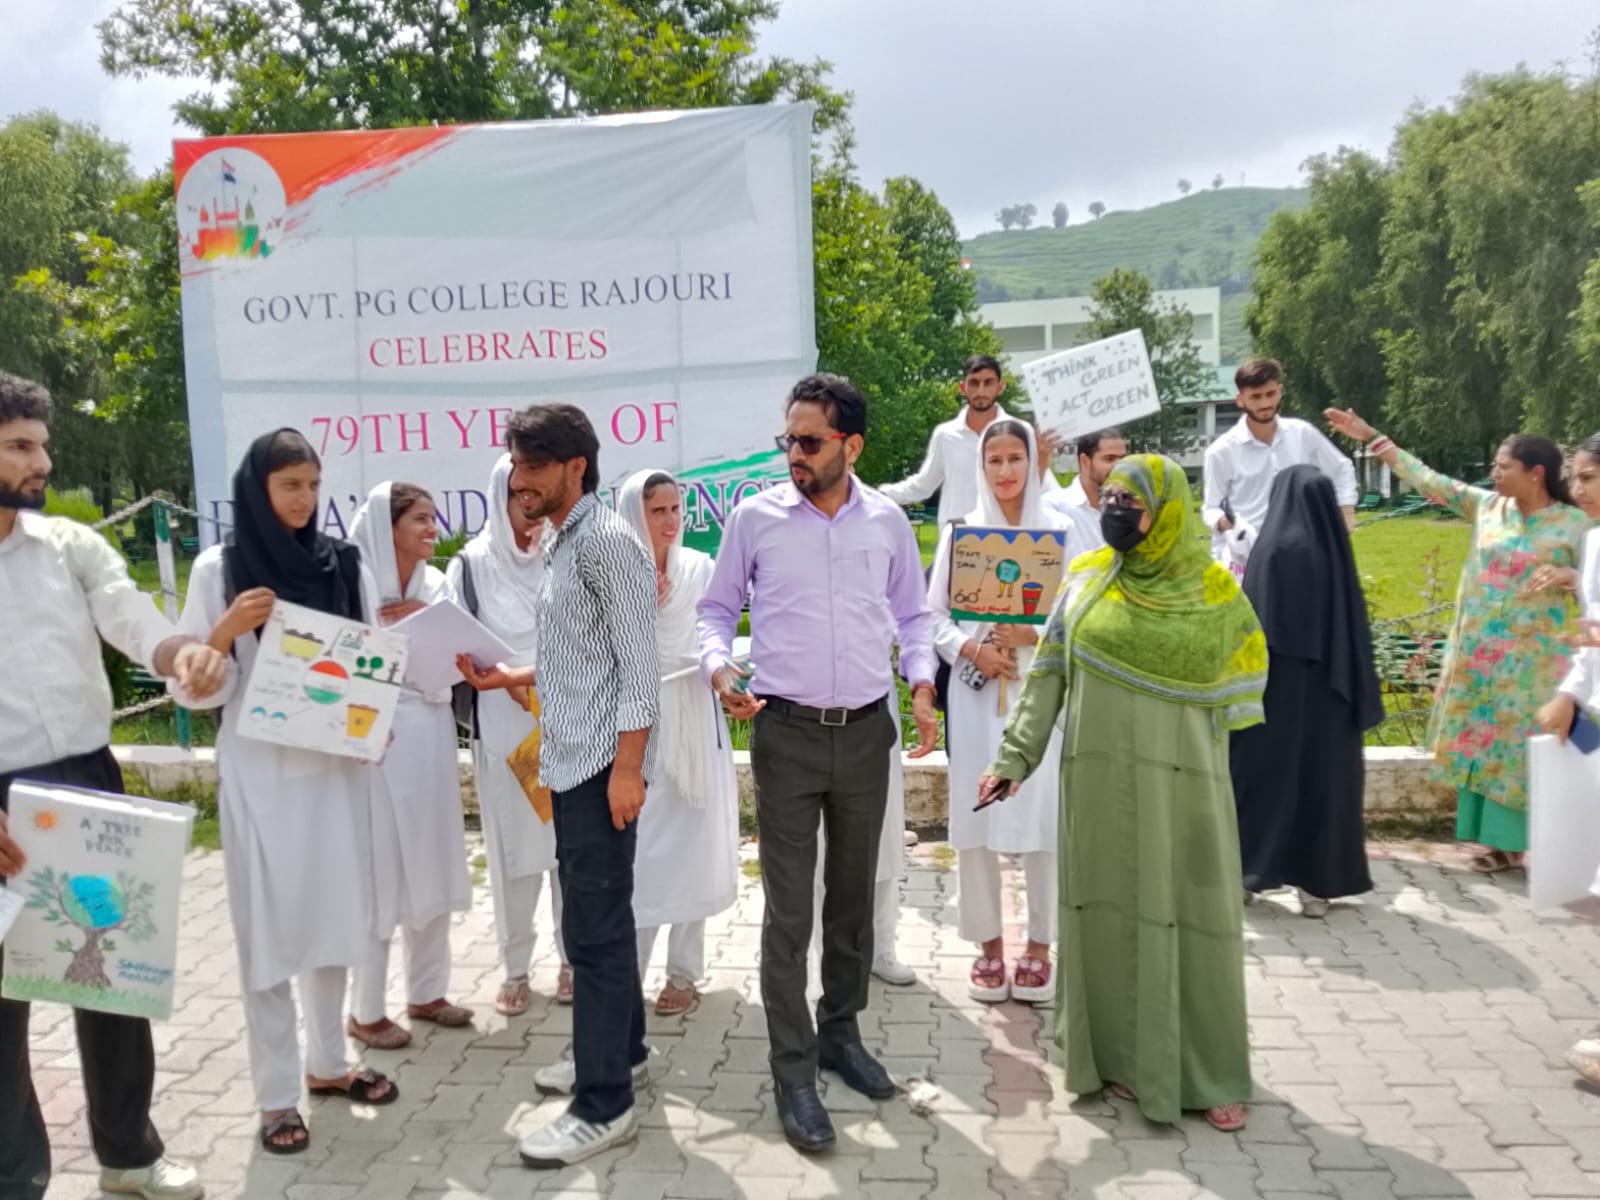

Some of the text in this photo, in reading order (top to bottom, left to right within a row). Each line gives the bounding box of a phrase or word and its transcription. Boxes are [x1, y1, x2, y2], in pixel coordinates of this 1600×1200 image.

[243, 272, 733, 324] GOVT. PG COLLEGE RAJOURI
[369, 328, 608, 368] CELEBRATES
[1042, 355, 1098, 385] THINK
[1080, 355, 1141, 388] GREEN
[1059, 389, 1092, 416] ACT
[1087, 383, 1150, 418] GREEN
[311, 411, 432, 456] 79TH
[610, 401, 679, 445] OF
